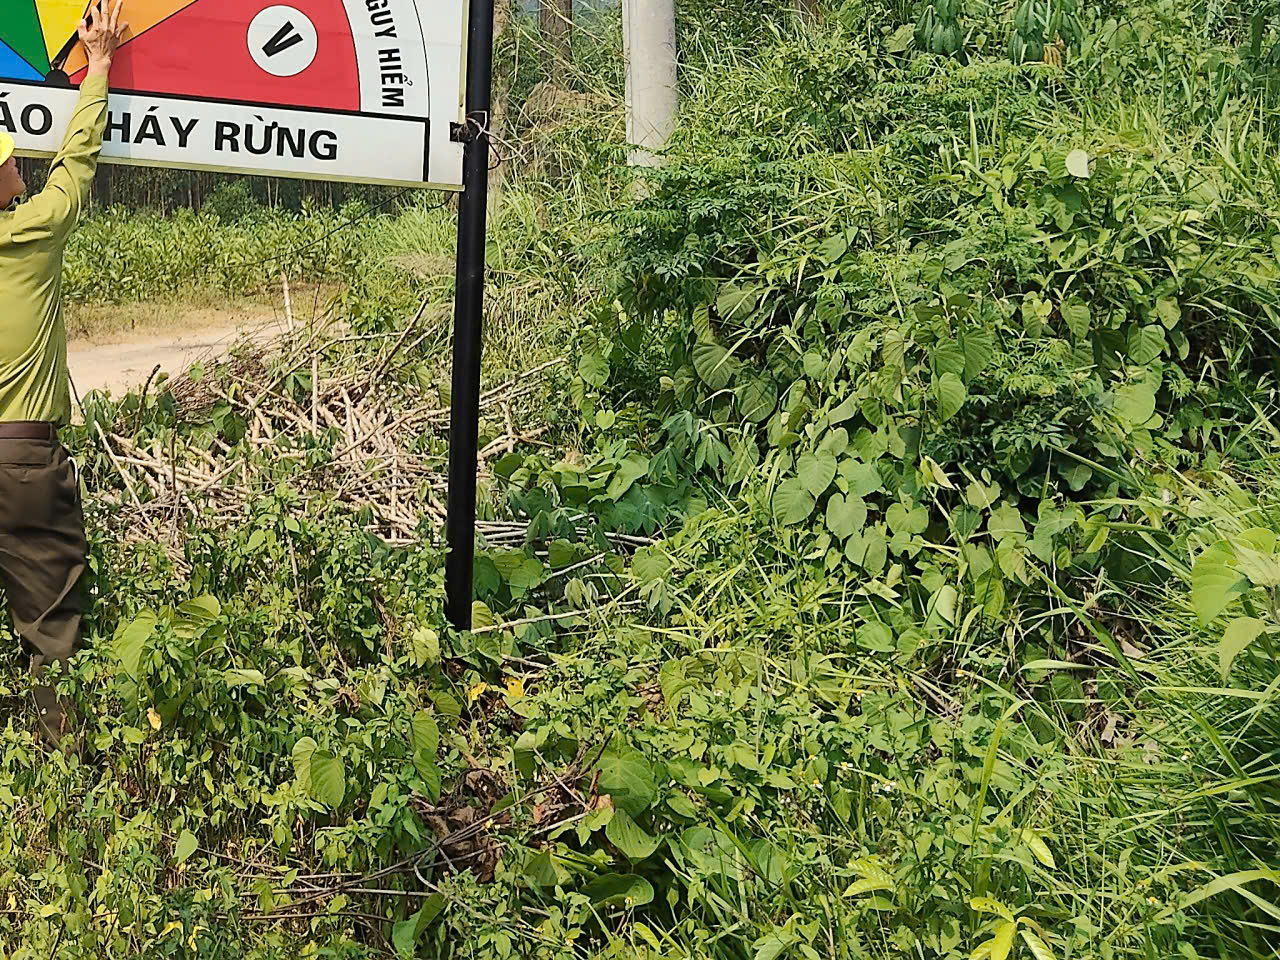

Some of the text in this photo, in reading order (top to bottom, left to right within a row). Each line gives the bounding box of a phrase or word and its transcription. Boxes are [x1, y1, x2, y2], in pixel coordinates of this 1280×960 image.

[261, 20, 304, 58] V
[377, 47, 414, 108] HIỂM
[103, 106, 199, 148] HÁY
[214, 114, 338, 161] RỪNG
